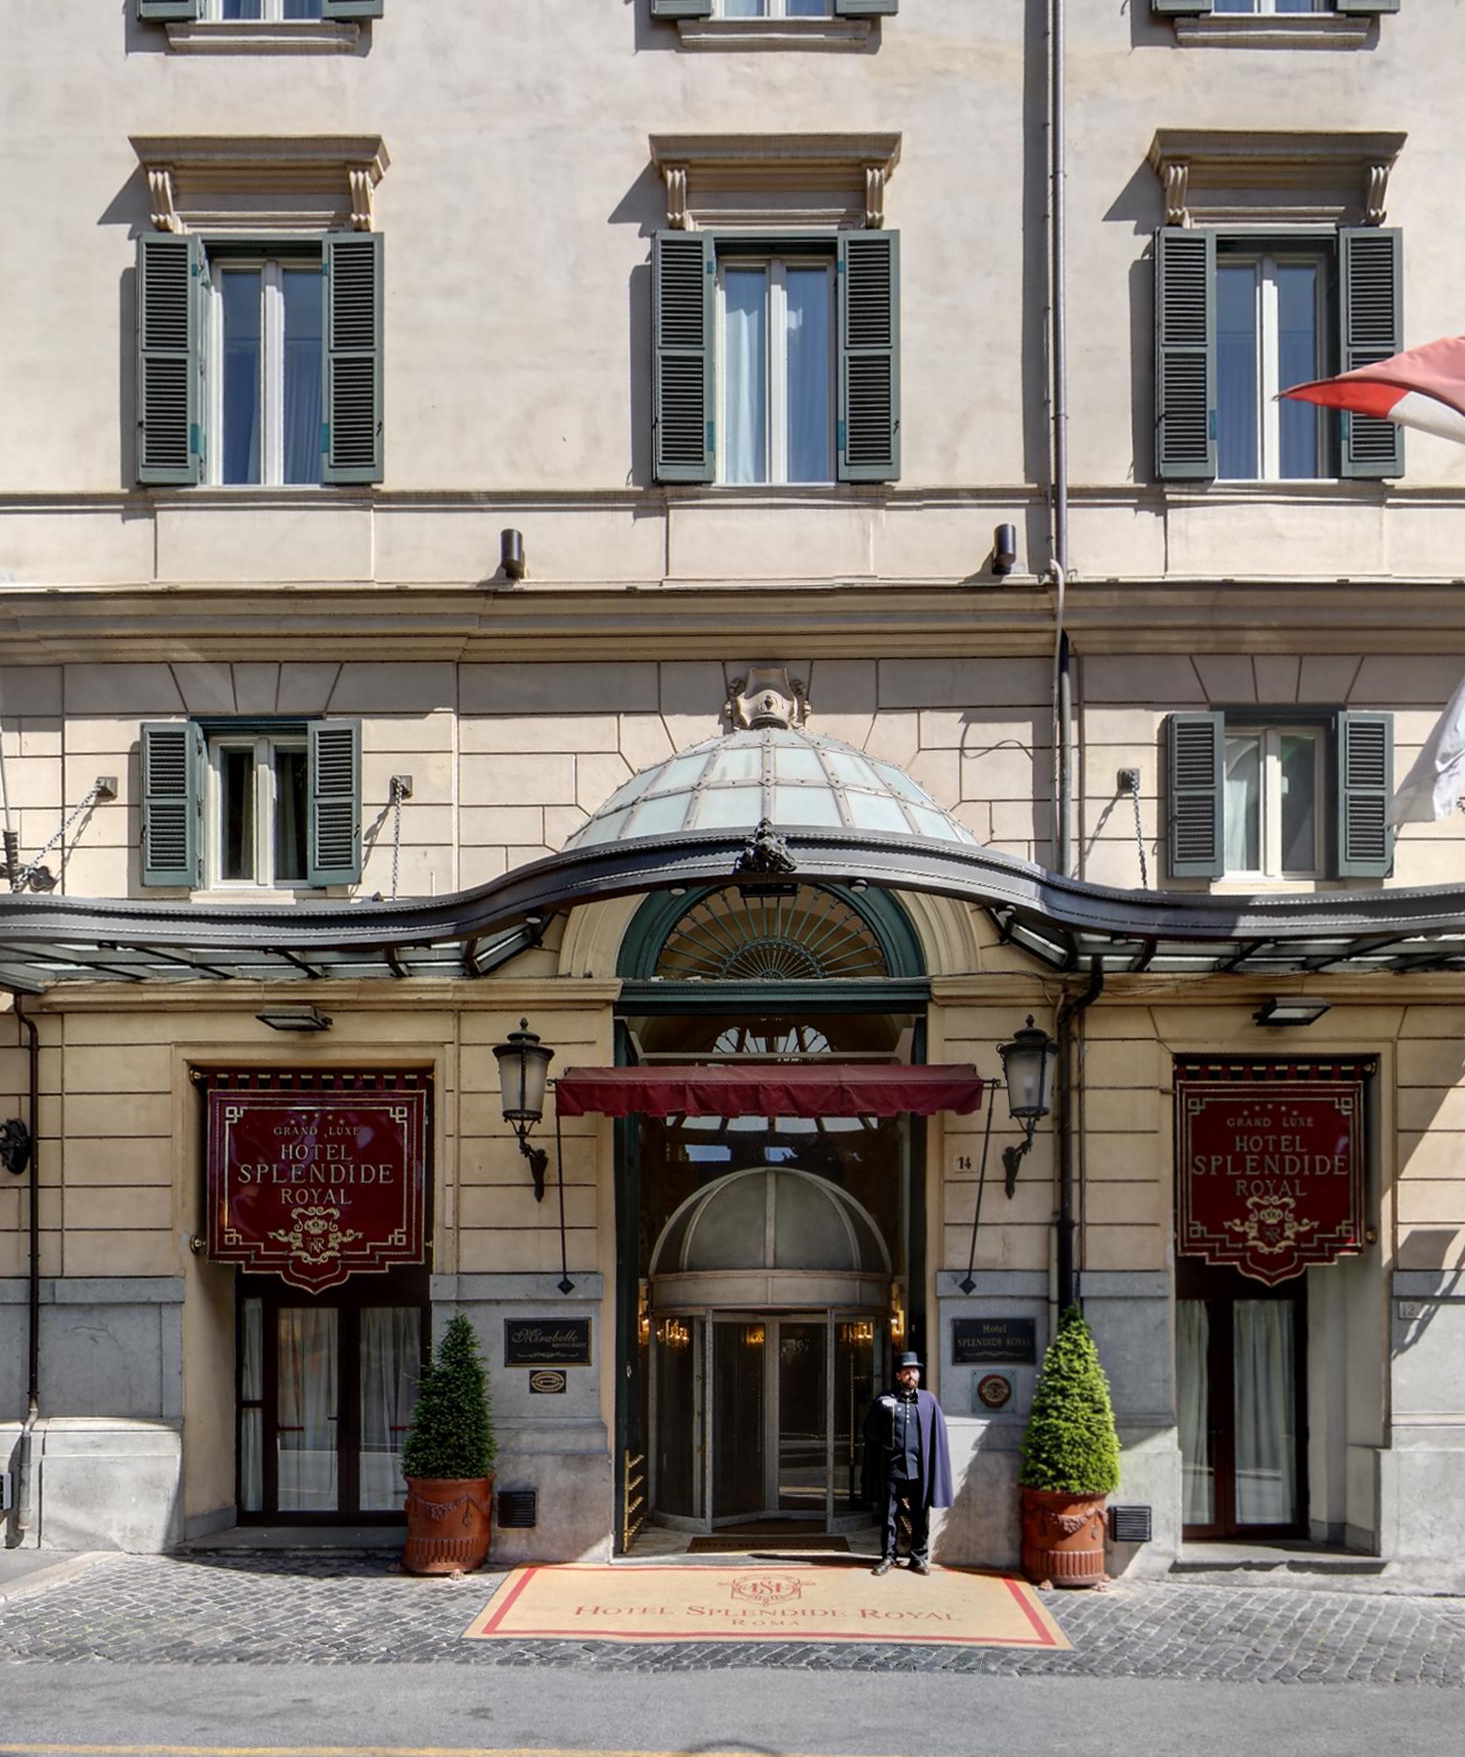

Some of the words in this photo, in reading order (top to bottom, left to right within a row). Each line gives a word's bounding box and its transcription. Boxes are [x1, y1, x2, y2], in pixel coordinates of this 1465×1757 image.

[1226, 1117, 1272, 1128] GRAND
[1281, 1117, 1316, 1128] LUXE
[273, 1126, 318, 1136] GRAND
[328, 1126, 362, 1136] LUXE
[280, 1143, 353, 1161] HOTEL
[1234, 1135, 1308, 1153] HOTEL
[956, 1155, 972, 1170] 14
[1191, 1154, 1350, 1176] SPLENDIDE
[237, 1163, 395, 1185] SPLENDIDE
[1234, 1179, 1308, 1197] ROYAL
[280, 1187, 353, 1206] ROYAL
[511, 1328, 578, 1344] Mirabelle
[982, 1323, 1008, 1334] Hotel
[957, 1337, 1002, 1347] SPLENDIDE
[1006, 1337, 1031, 1347] ROYAL
[731, 1618, 800, 1626] ROMA
